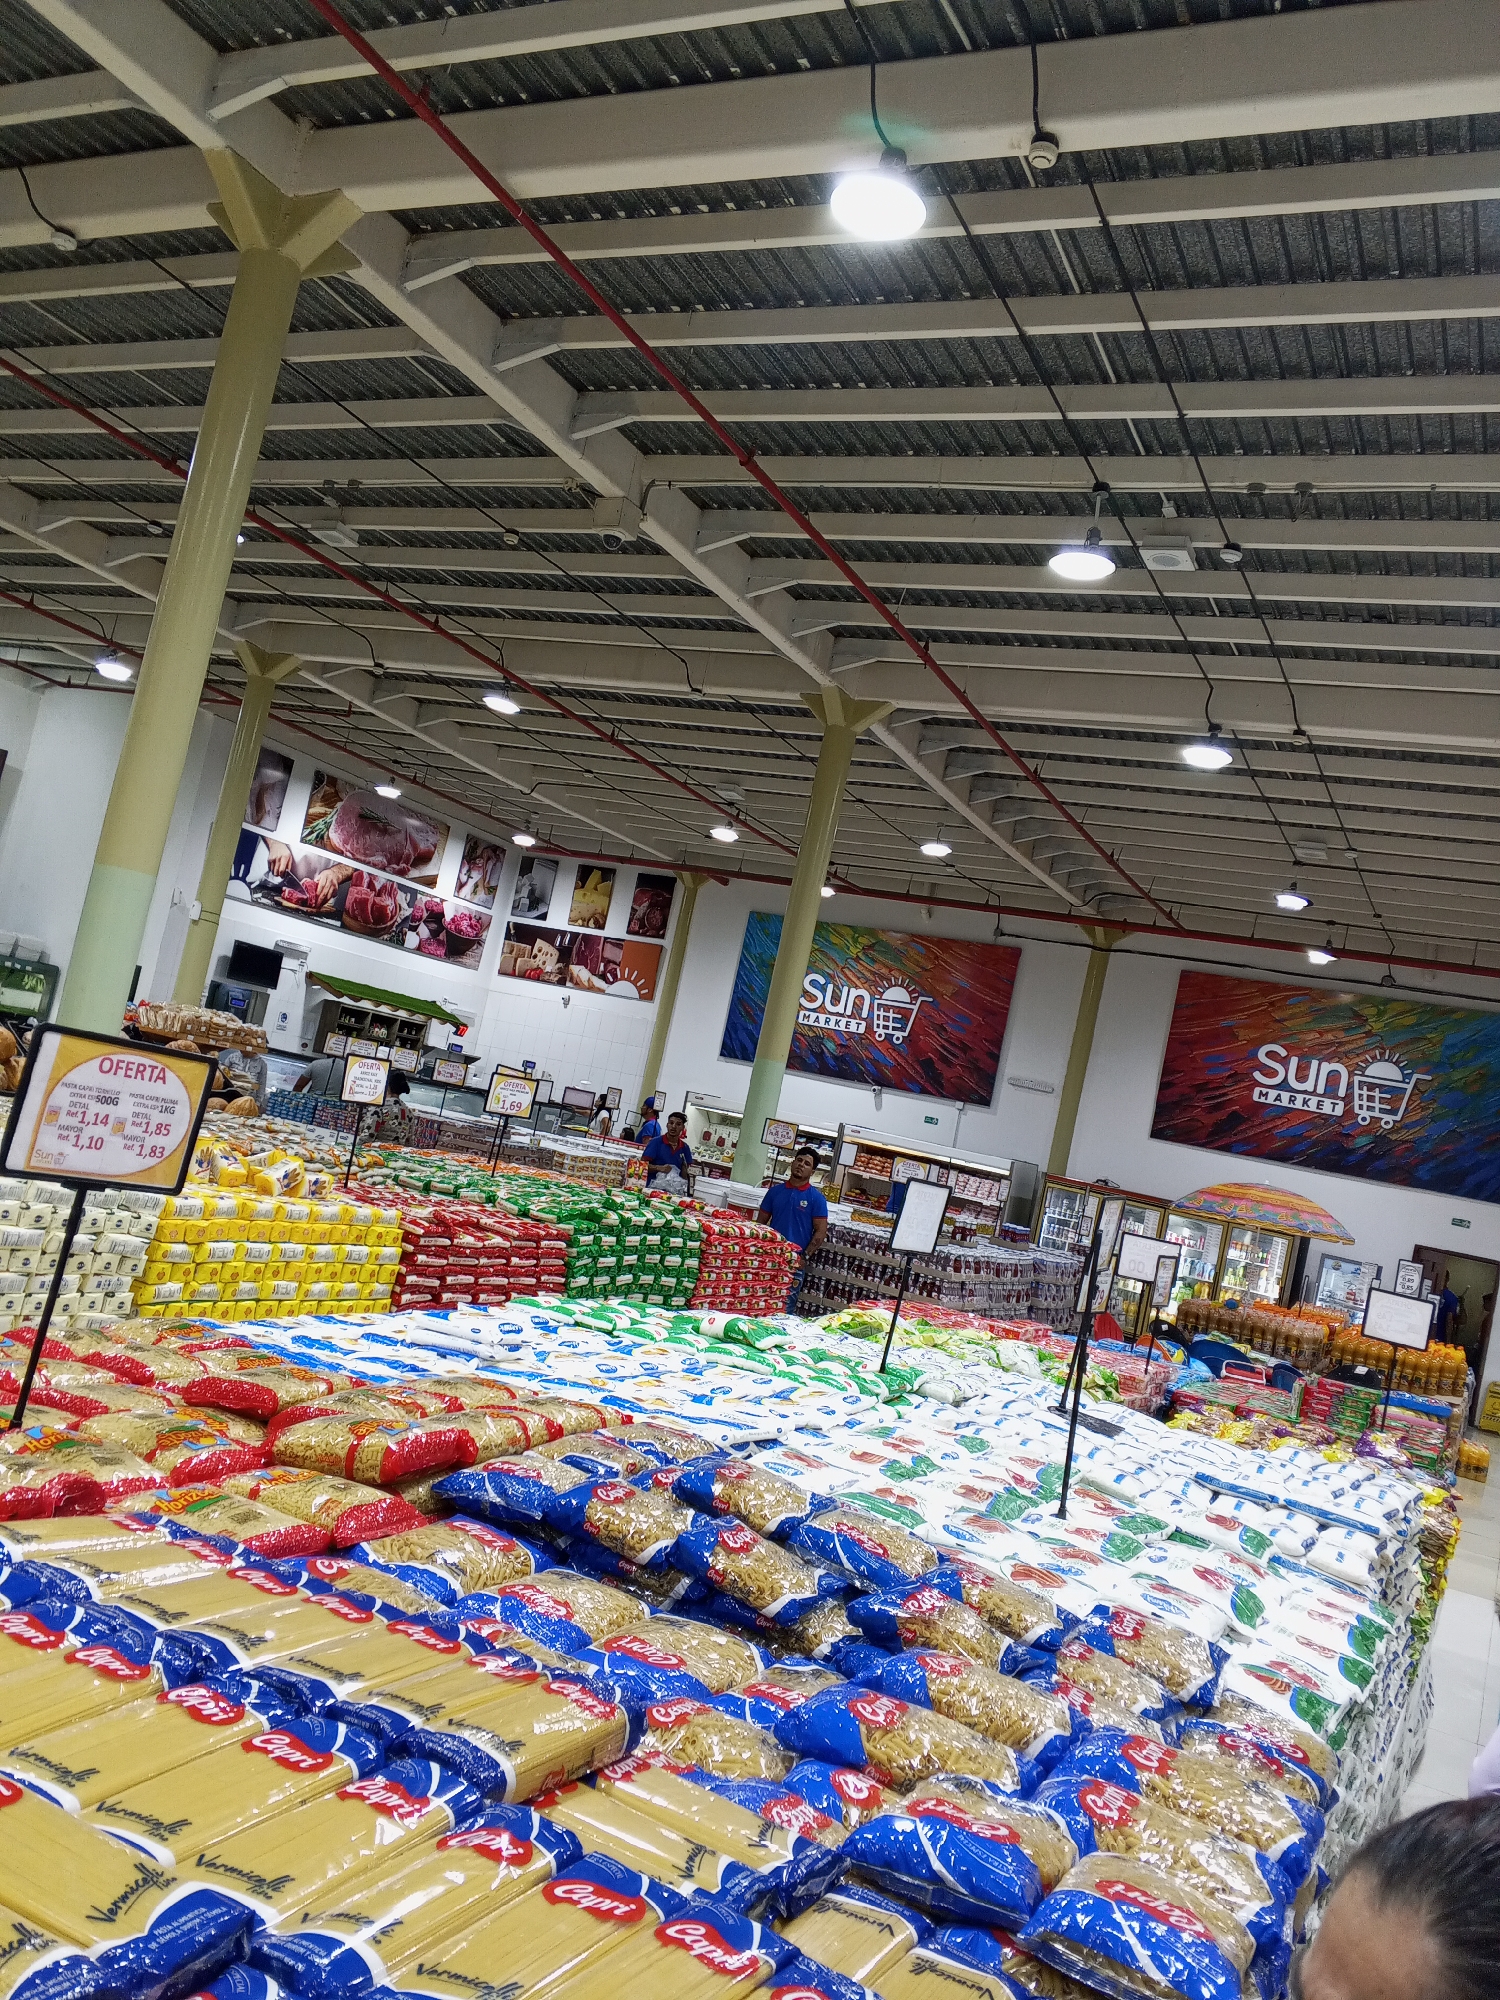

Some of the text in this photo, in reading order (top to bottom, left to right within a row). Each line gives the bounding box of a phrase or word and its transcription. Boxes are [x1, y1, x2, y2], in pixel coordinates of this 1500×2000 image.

[799, 973, 871, 1019] Sun
[801, 1012, 863, 1033] MARKET
[98, 1056, 167, 1085] OFERTA
[358, 1061, 381, 1072] OFERTA
[1252, 1043, 1350, 1099] Sun
[503, 1080, 527, 1091] OFERTA
[69, 1100, 90, 1111] DETAL
[95, 1095, 119, 1106] 500G
[159, 1105, 176, 1115] 1KG
[501, 1099, 523, 1113] 1,69
[1257, 1090, 1341, 1114] MARKET
[66, 1110, 110, 1127] Ref. 1,14
[131, 1111, 152, 1121] DETAL
[57, 1124, 84, 1134] MAYOR
[122, 1133, 146, 1143] MAYOR
[142, 1121, 172, 1137] 1,85
[57, 1133, 104, 1151] Ref. 1,10
[136, 1143, 166, 1159] 1,83
[34, 1149, 53, 1160] Sun
[598, 1484, 631, 1501] Capri
[713, 1500, 730, 1513] Capri
[235, 1570, 291, 1594] Capri
[707, 1568, 723, 1584] Capri
[310, 1596, 366, 1619] Capri
[0, 1614, 56, 1645] Capri
[757, 1615, 775, 1630] Capri
[612, 1637, 679, 1666] Capri
[75, 1648, 141, 1676] Capri
[168, 1687, 235, 1721] Capri
[252, 1734, 324, 1769] Capri
[604, 1754, 645, 1780] Capri
[345, 1779, 421, 1814] Capri
[95, 1800, 193, 1836] Vermicelli
[195, 1853, 296, 1893] Vermicelli
[86, 1862, 165, 1925] Vermicelli
[554, 1884, 636, 1916] Capri
[1107, 1884, 1206, 1933] Capri
[153, 1924, 171, 1937] PASTA
[147, 1941, 158, 1951] DE
[665, 1923, 750, 1971] Capri
